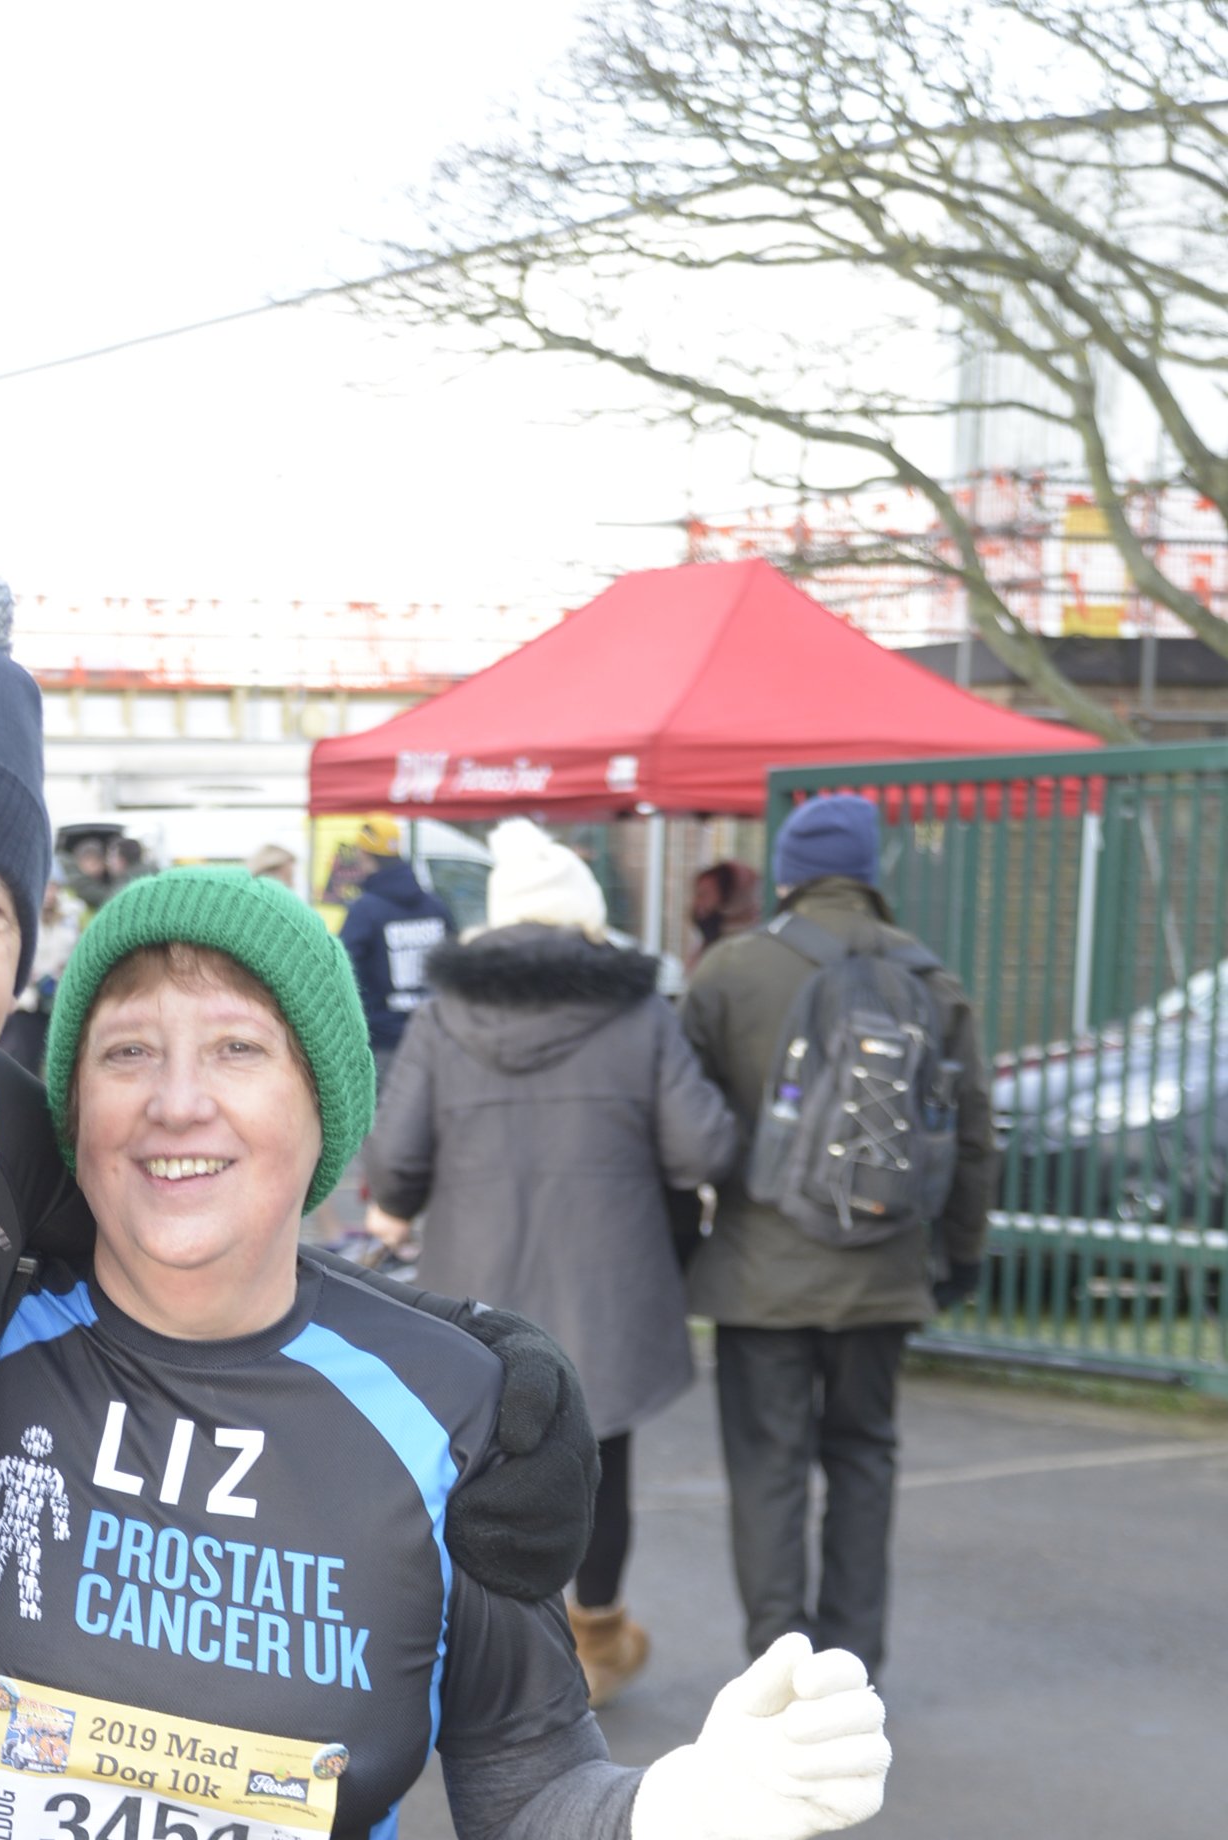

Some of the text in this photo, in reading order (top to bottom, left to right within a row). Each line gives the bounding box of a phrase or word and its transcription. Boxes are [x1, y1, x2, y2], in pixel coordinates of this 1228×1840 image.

[91, 1400, 266, 1519] LIZ
[81, 1508, 346, 1620] PROSTATE
[75, 1573, 372, 1692] CANCER UK
[88, 1716, 240, 1771] 2019 Mad
[92, 1753, 222, 1800] Dog 10k
